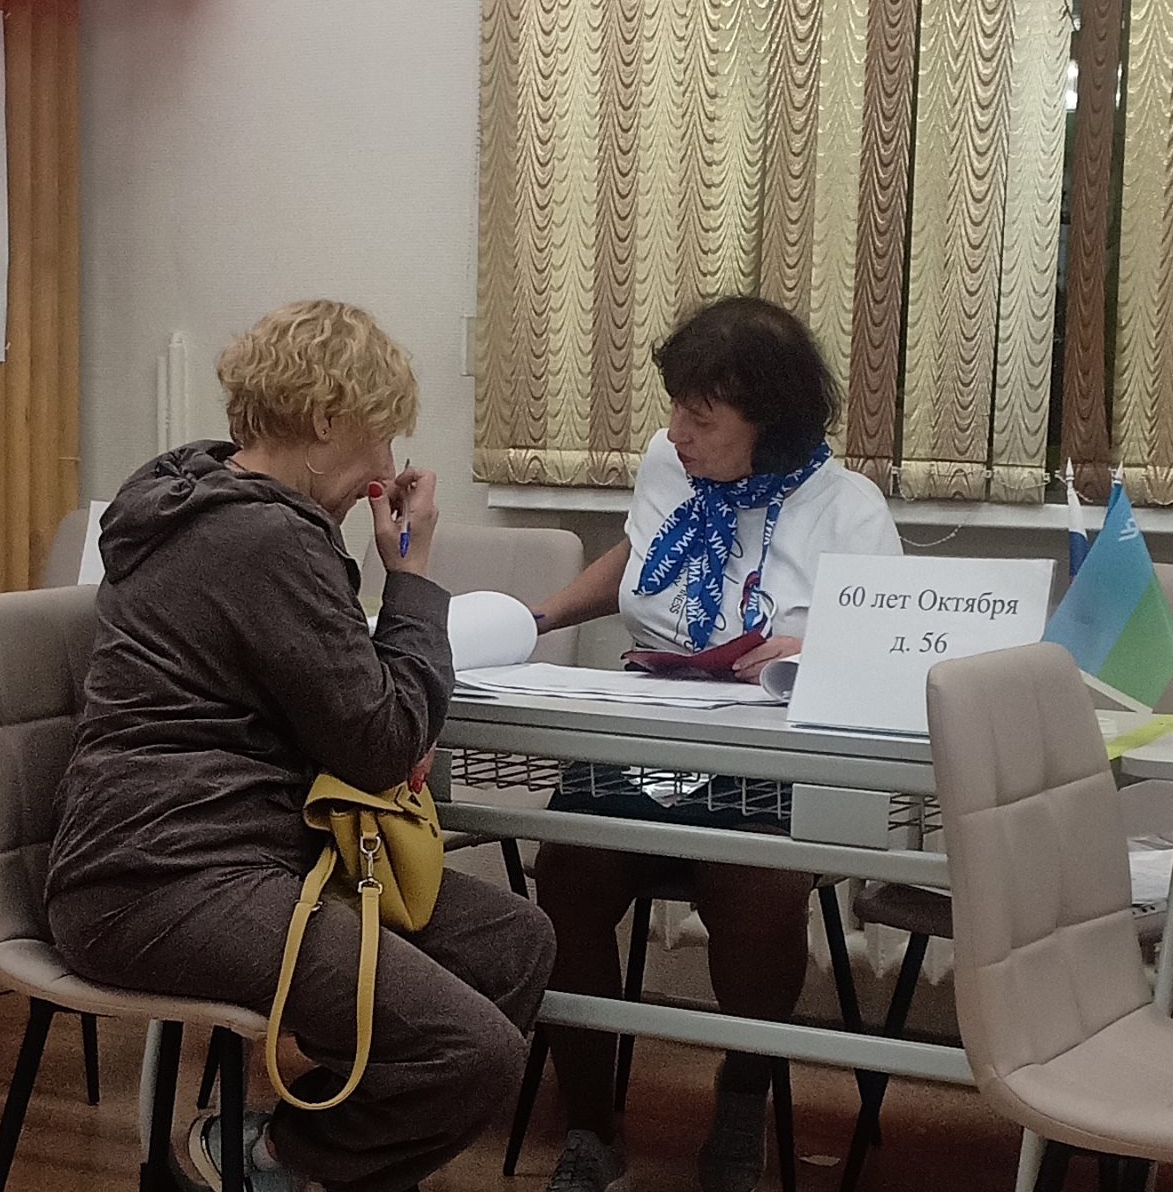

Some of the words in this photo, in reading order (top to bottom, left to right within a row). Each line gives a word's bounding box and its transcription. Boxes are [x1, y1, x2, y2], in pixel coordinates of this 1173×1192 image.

[655, 513, 681, 541] УИК
[670, 527, 698, 555] УИК
[708, 529, 729, 565] УИК
[648, 554, 677, 587] УИК
[688, 555, 703, 584] УИК
[705, 577, 723, 606] УИ
[838, 585, 866, 607] 60
[871, 592, 911, 609] лет
[918, 589, 1019, 620] Октября
[687, 596, 701, 626] УИК
[889, 636, 911, 654] д.
[919, 632, 950, 654] 56
